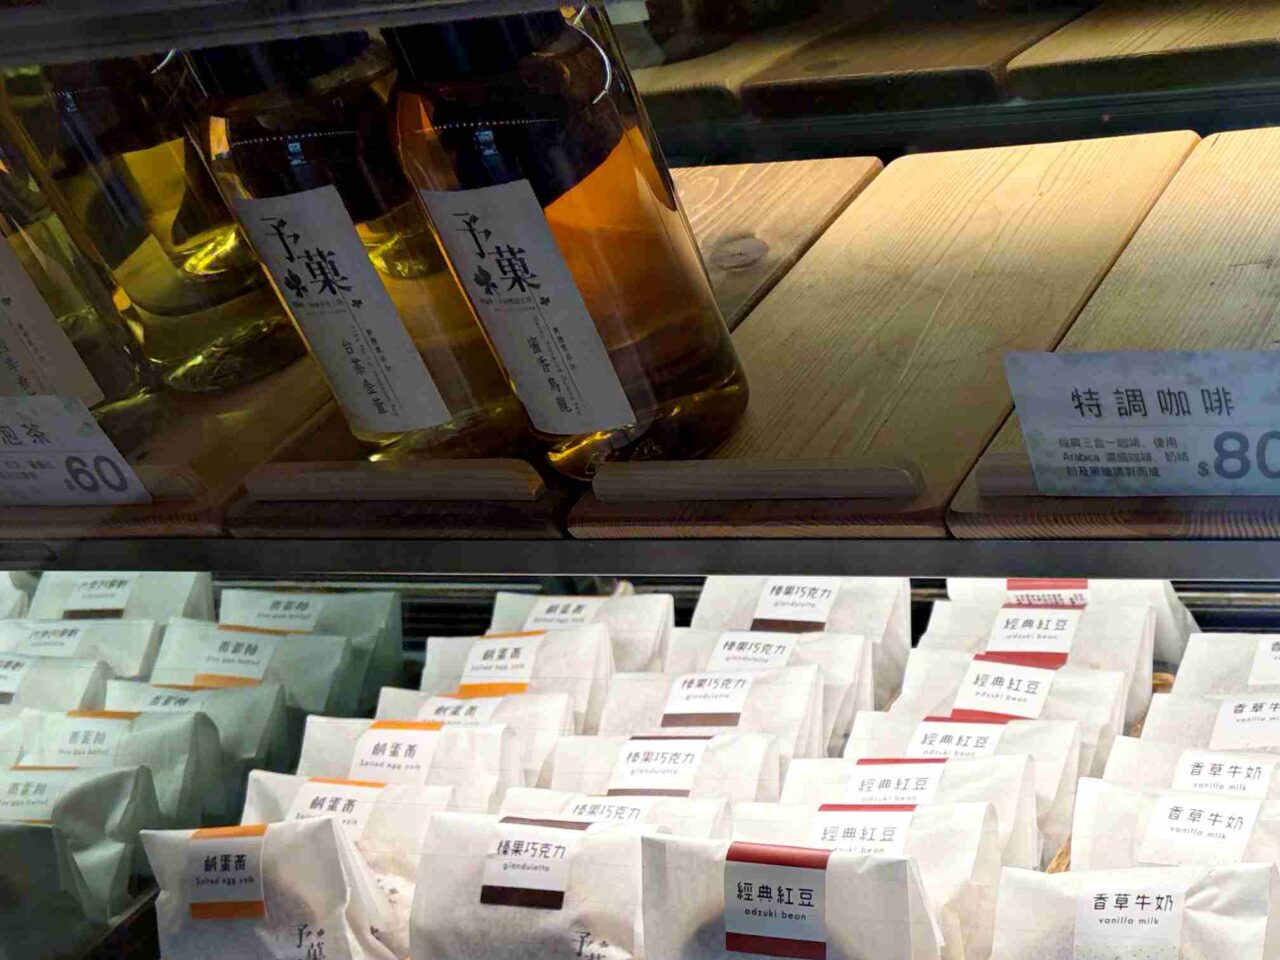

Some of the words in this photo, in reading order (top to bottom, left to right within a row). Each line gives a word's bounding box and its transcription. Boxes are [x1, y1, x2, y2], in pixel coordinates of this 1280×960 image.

[1072, 387, 1235, 418] 特調咖啡
[1004, 618, 1069, 631] 經典紅豆
[973, 673, 1041, 695] 經典紅豆
[921, 732, 990, 749] 經典紅豆
[1190, 762, 1262, 780] 香草牛奶
[858, 777, 930, 792] 經典紅豆
[1193, 782, 1224, 791] vanilla
[1228, 784, 1247, 792] milk
[1168, 806, 1244, 831] 香草牛奶
[821, 826, 898, 843] 經典紅豆
[1170, 825, 1202, 836] vanilla
[1207, 831, 1226, 840] milk
[497, 840, 566, 859] 榛果巧克力
[204, 854, 247, 872] 鹹蛋黃
[737, 881, 815, 908] 經典紅豆
[1093, 893, 1173, 912] 香草牛奶
[745, 907, 777, 918] adzuki
[782, 910, 807, 920] bean
[1099, 916, 1134, 925] vanilla
[1138, 916, 1159, 926] milk
